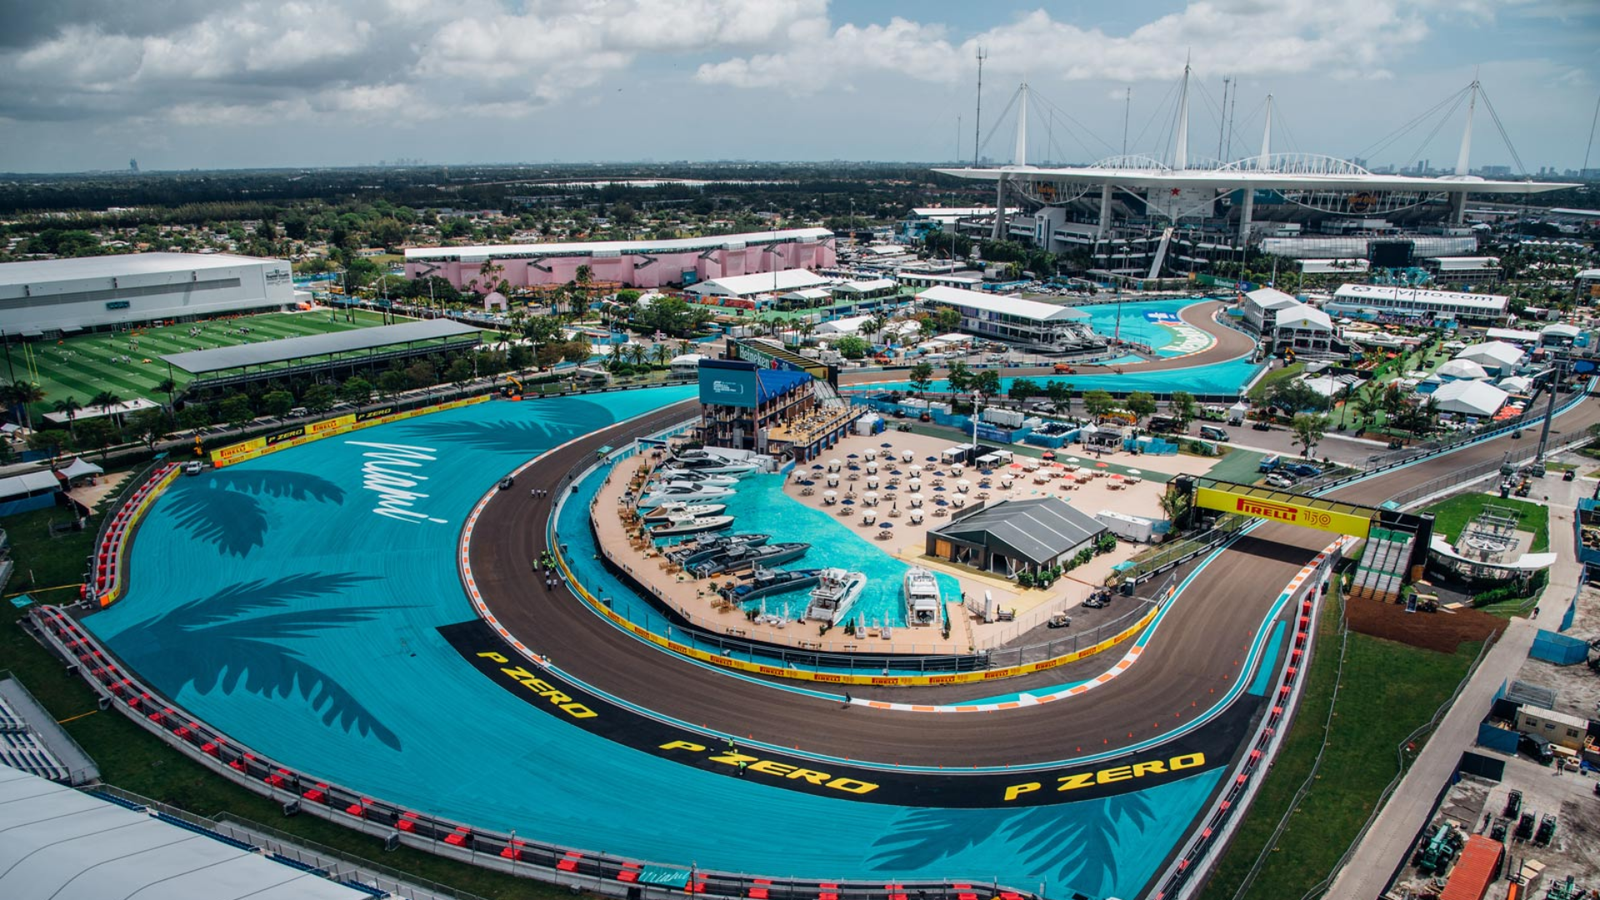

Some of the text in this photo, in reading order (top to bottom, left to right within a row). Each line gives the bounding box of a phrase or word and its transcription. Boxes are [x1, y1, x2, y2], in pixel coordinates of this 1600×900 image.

[1378, 288, 1493, 302] crypto.com
[739, 345, 771, 370] Heineken
[366, 408, 392, 418] ZERO
[277, 429, 304, 440] ZERO
[220, 444, 246, 458] PIRELLI
[1236, 498, 1332, 525] PIRELLI 150
[710, 655, 733, 666] PIRELLI
[759, 666, 785, 676] PIRELLI
[984, 669, 1009, 679] PIRELLI
[814, 674, 841, 682] PIRELLI
[929, 675, 955, 684] PIRELLI
[476, 652, 598, 718] P ZERO
[658, 740, 880, 794] P ZERO
[1004, 752, 1206, 801] P ZERO
